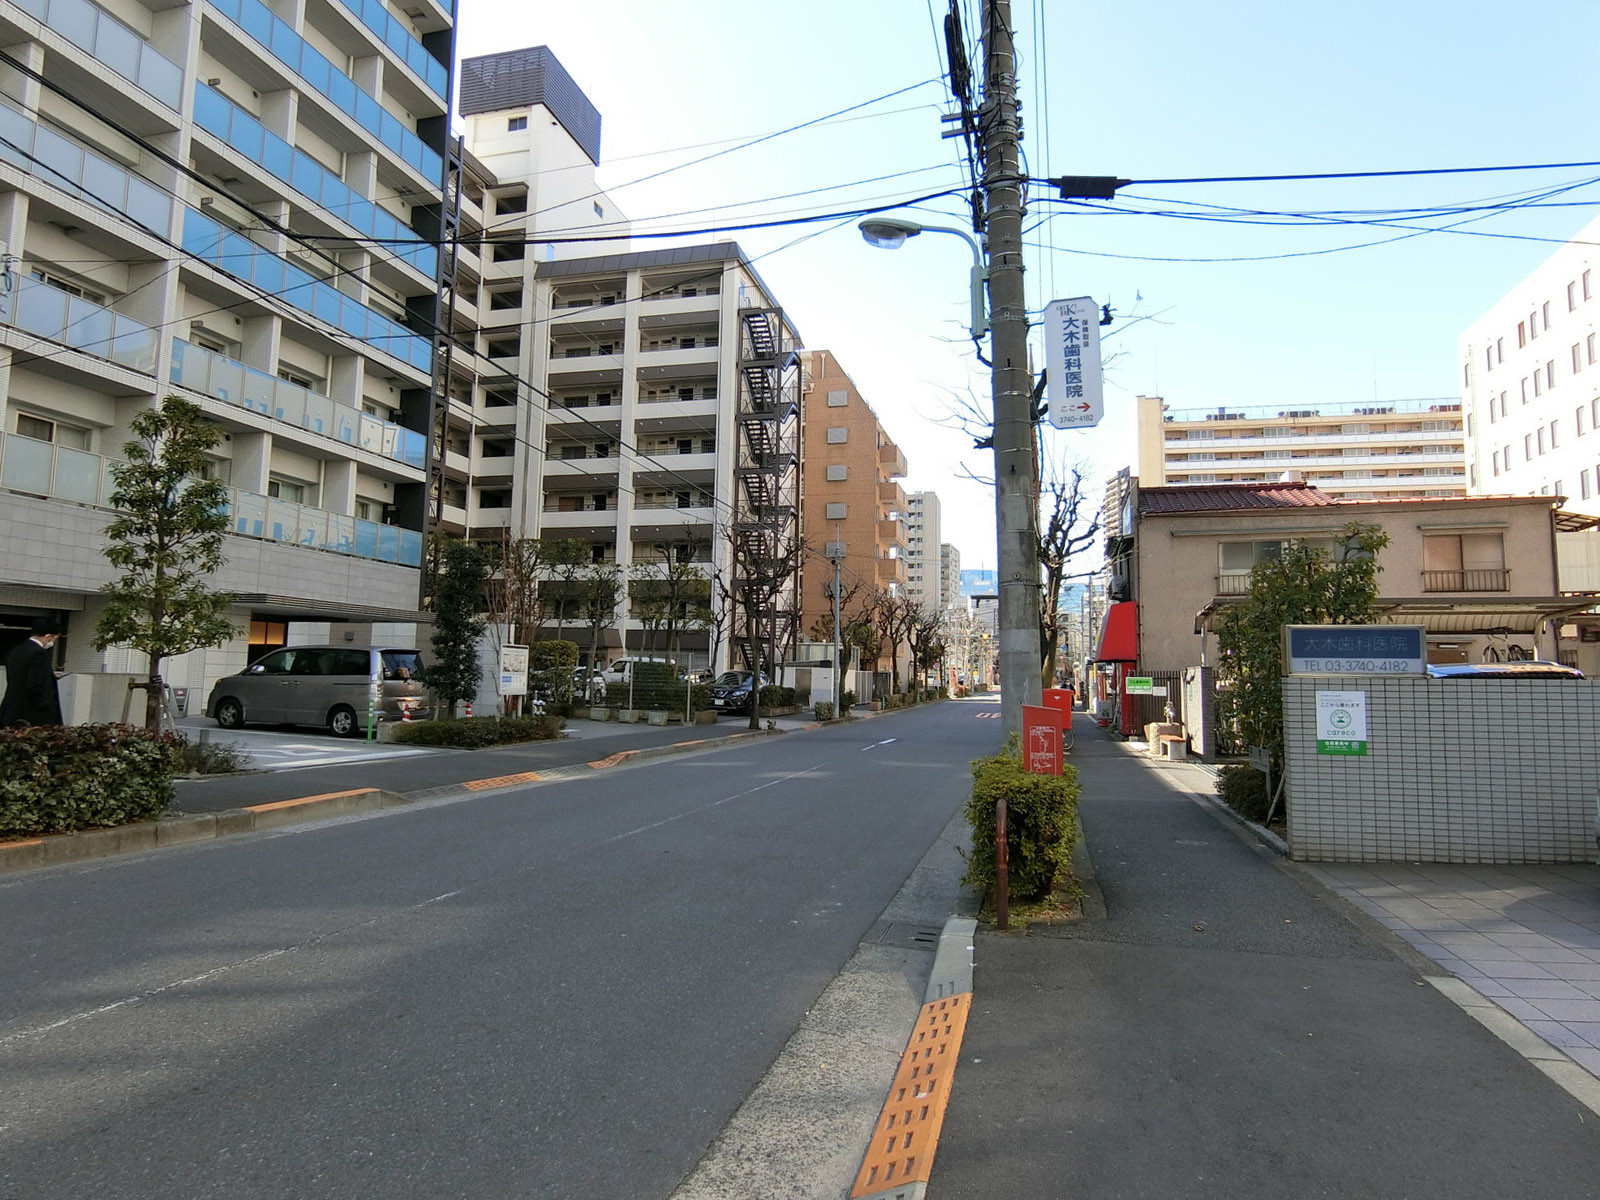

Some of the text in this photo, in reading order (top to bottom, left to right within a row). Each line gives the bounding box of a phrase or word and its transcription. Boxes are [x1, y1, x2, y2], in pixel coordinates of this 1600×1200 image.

[1062, 317, 1083, 398] 大木歯科医院
[1059, 414, 1093, 424] 3740-4182
[1303, 635, 1408, 653] 大木歯科医院
[1303, 660, 1408, 672] TEL 03-3740-4182
